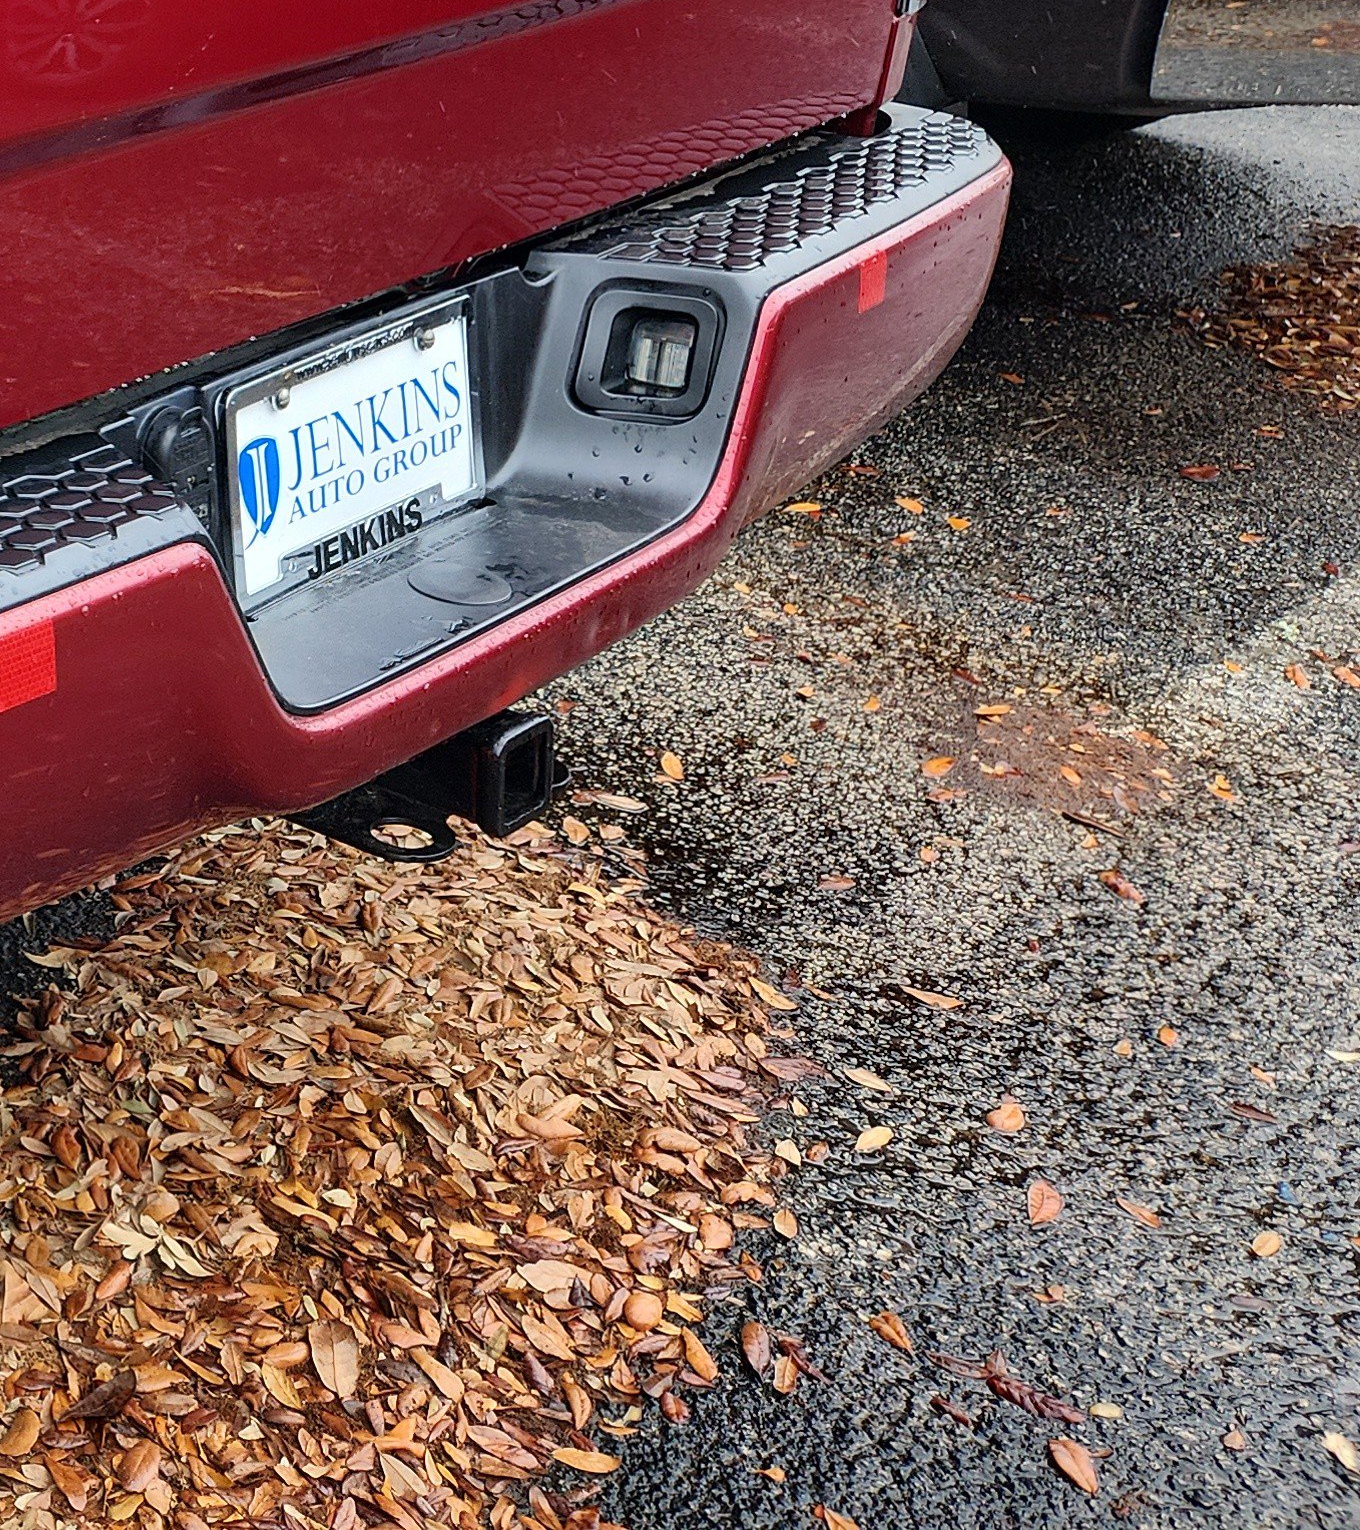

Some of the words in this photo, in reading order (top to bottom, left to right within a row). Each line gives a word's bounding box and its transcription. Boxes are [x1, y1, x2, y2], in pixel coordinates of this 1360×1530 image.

[287, 361, 461, 491] JENKINS
[288, 469, 365, 525] AUTO
[373, 423, 463, 483] GROUP
[307, 496, 424, 580] JENKINS
